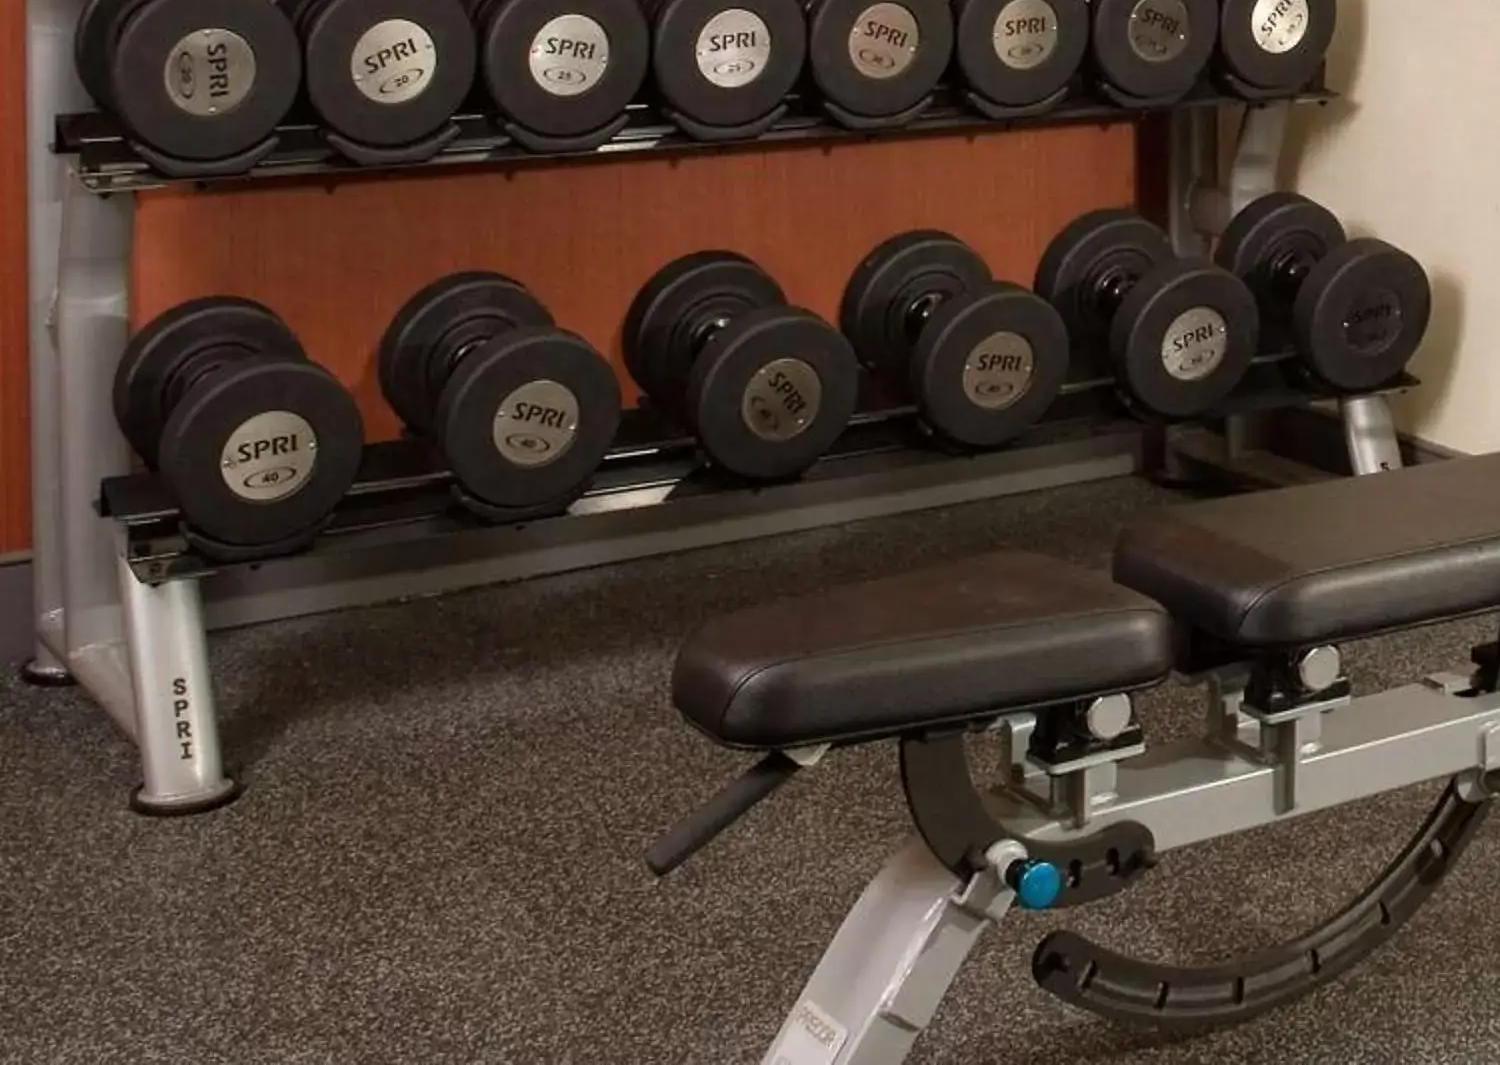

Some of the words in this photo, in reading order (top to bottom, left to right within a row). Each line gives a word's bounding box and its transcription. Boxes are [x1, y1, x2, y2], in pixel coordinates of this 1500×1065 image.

[863, 20, 909, 48] SPRI
[1004, 15, 1047, 36] SPRI
[1141, 7, 1181, 36] SPRI
[363, 37, 418, 74] SPRI
[545, 37, 596, 60] SPRI
[709, 30, 756, 53] SPRI
[206, 42, 229, 98] SPRI
[1172, 323, 1214, 353] SPRI
[977, 353, 1024, 372] SPRI
[767, 371, 808, 416] SPRI
[511, 401, 567, 429] SPRI
[236, 433, 299, 464] SPRI
[173, 678, 193, 760] SPRI
